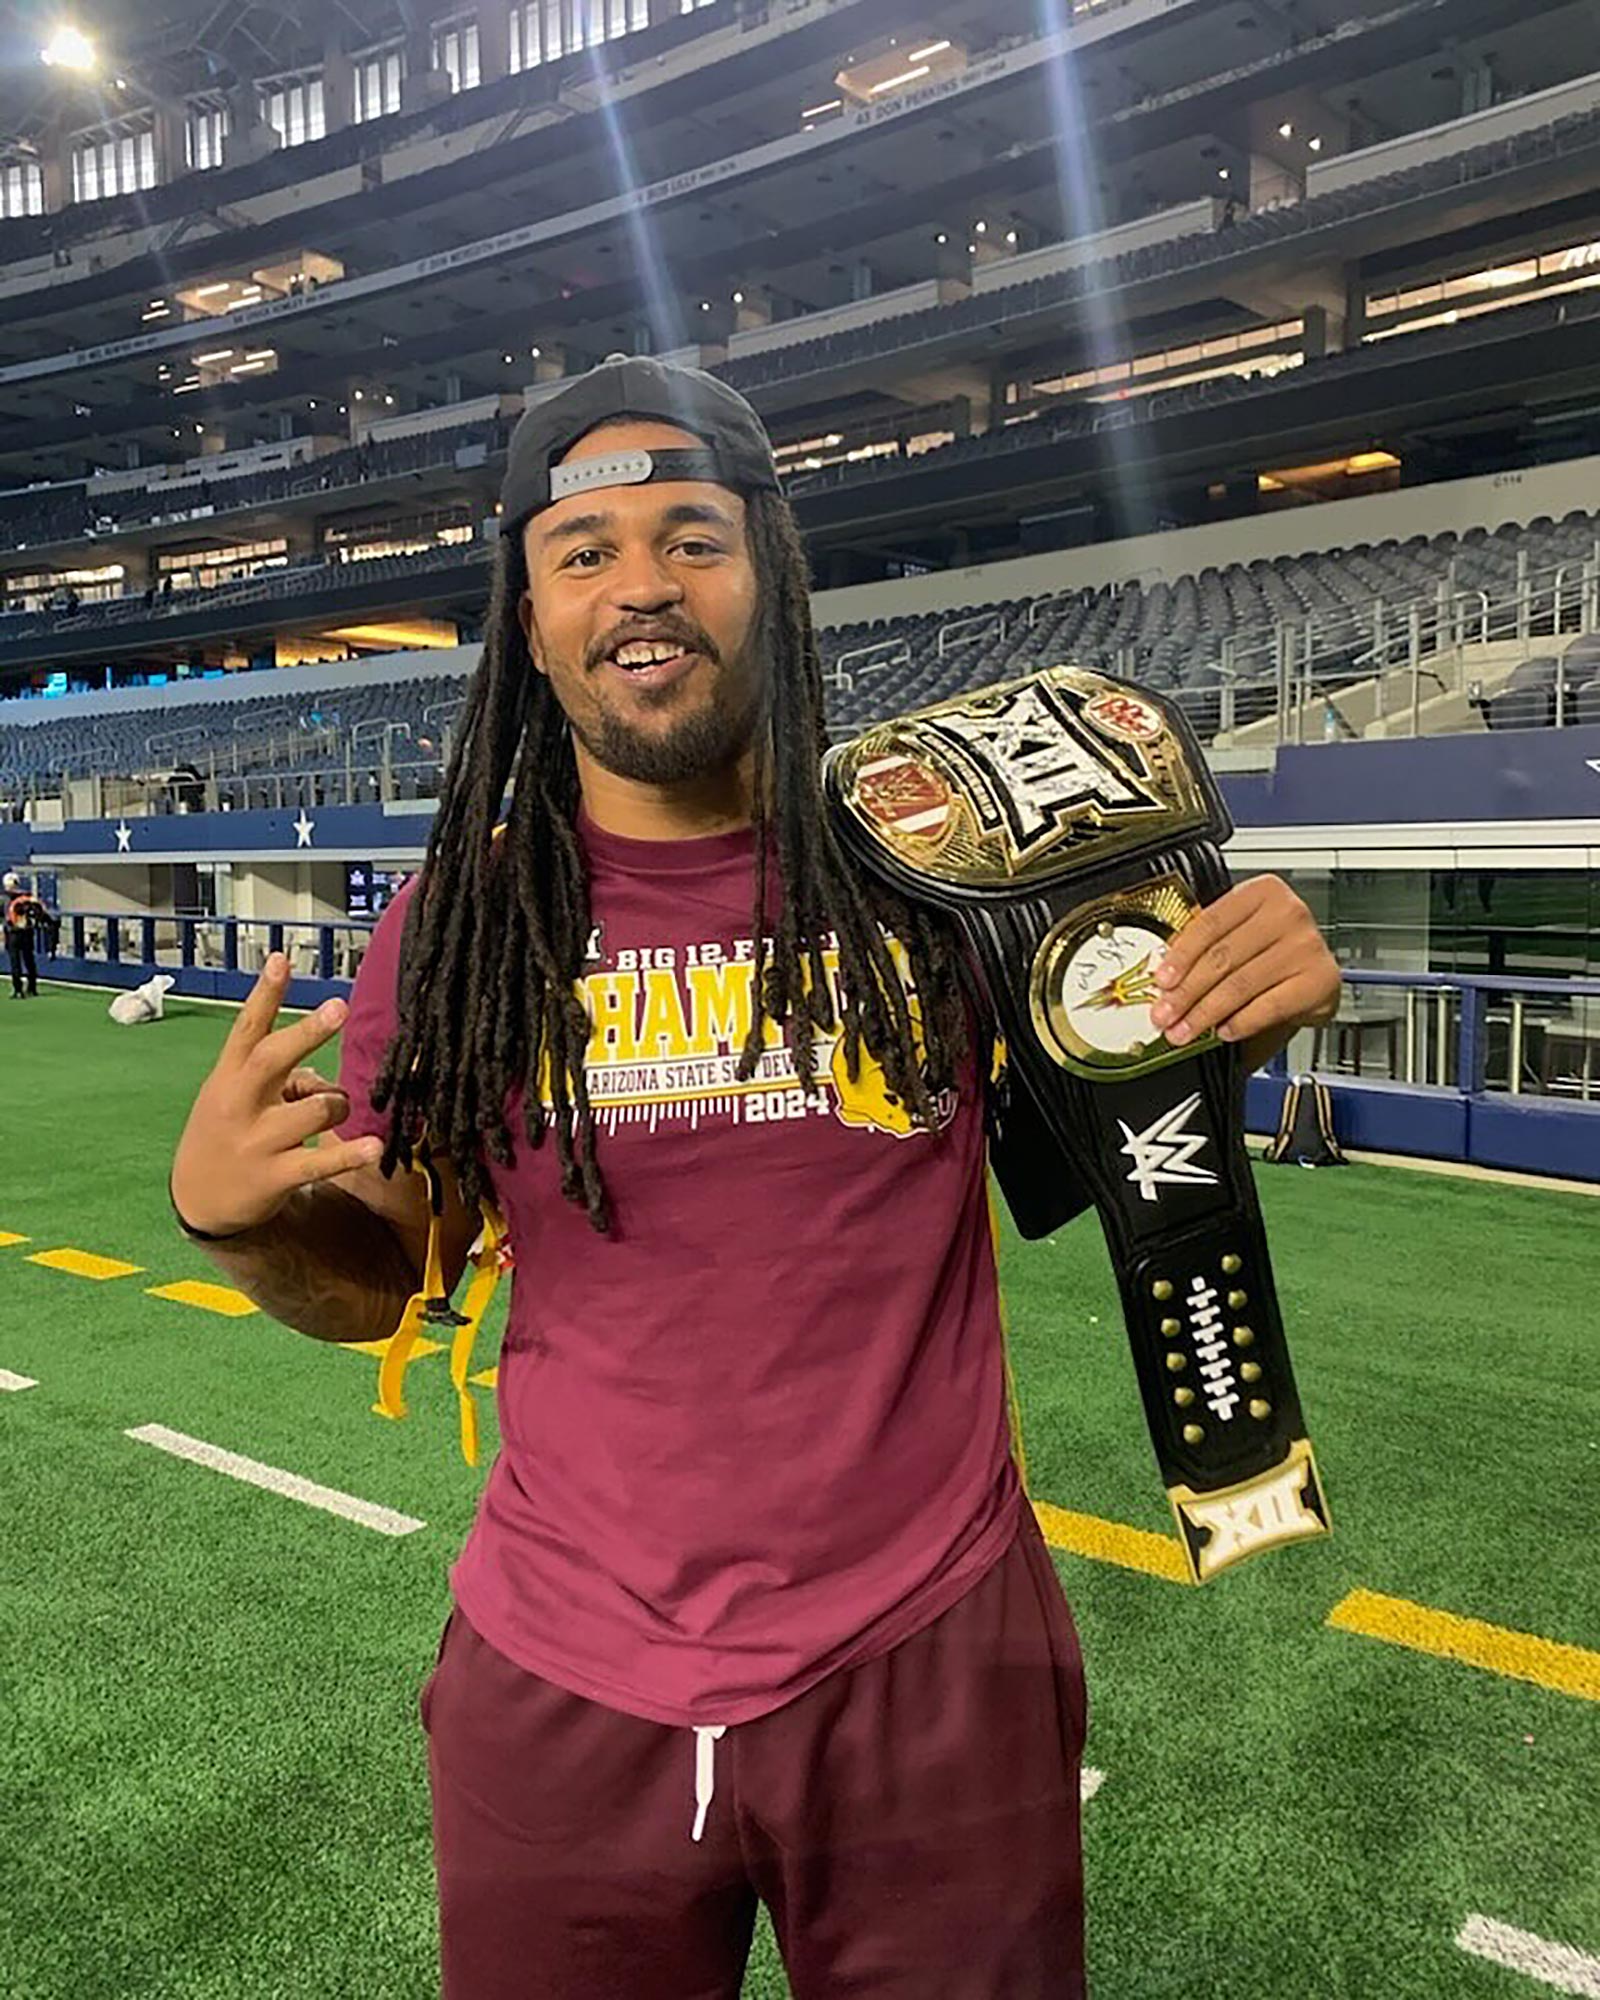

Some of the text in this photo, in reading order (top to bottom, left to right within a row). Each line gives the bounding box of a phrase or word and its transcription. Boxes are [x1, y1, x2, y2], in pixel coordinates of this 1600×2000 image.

[876, 101, 901, 119] DON
[905, 78, 959, 108] PERKINS
[616, 947, 676, 971] BIG
[590, 1068, 660, 1095] ARIZONA
[665, 1062, 717, 1089] STATE
[762, 1048, 819, 1079] DEVS
[745, 1085, 830, 1123] 2024
[1183, 1457, 1327, 1569] XII
